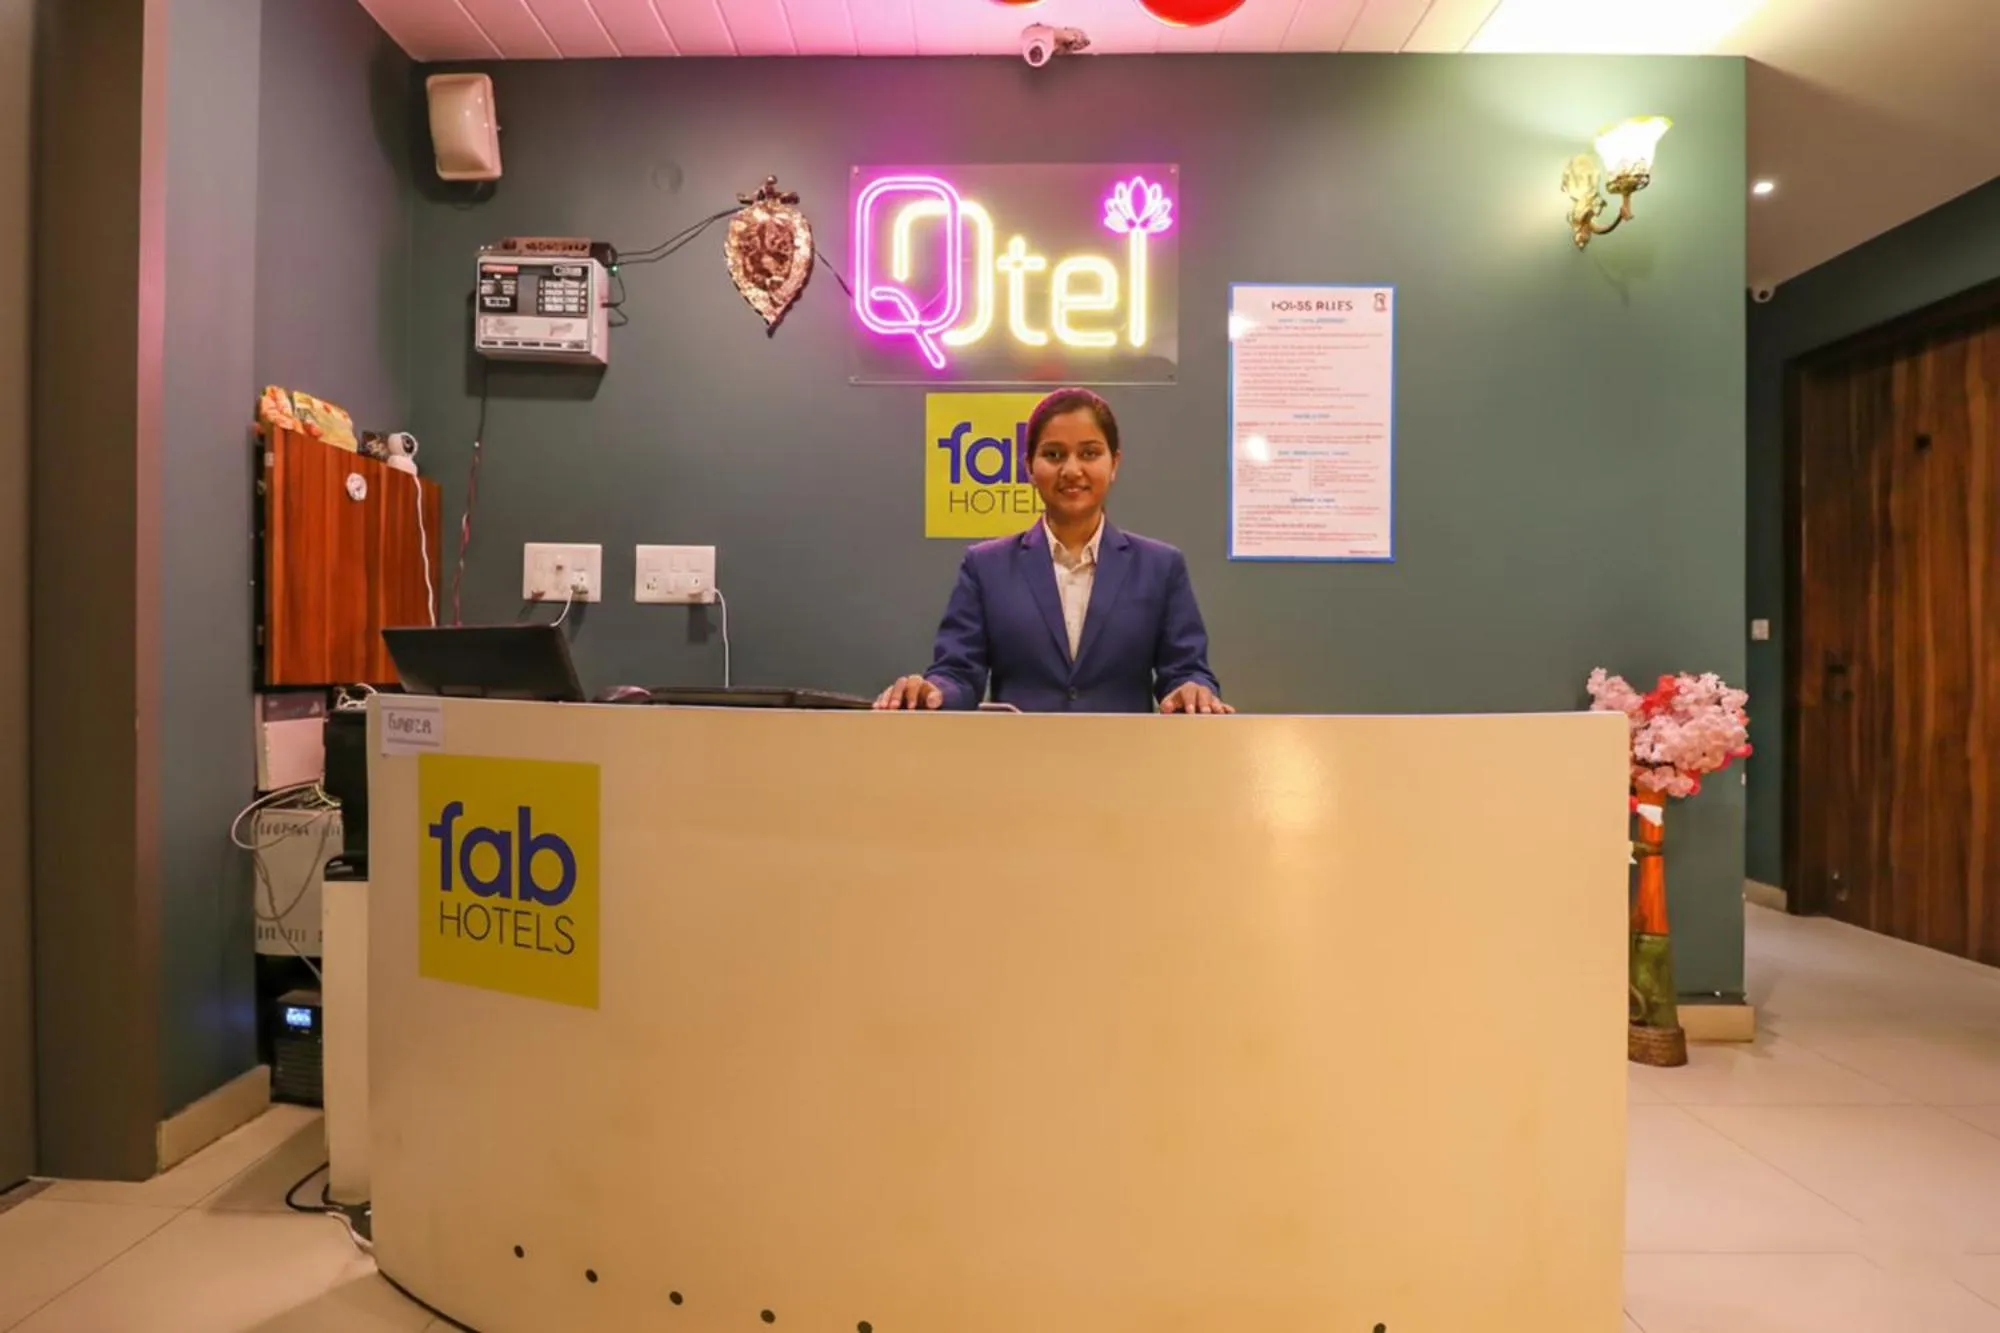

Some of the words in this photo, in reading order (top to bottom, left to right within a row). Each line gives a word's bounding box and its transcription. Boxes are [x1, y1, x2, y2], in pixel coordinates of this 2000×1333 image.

[949, 489, 1047, 515] HOTEL
[429, 801, 577, 906] fab
[440, 901, 575, 956] HOTELS
